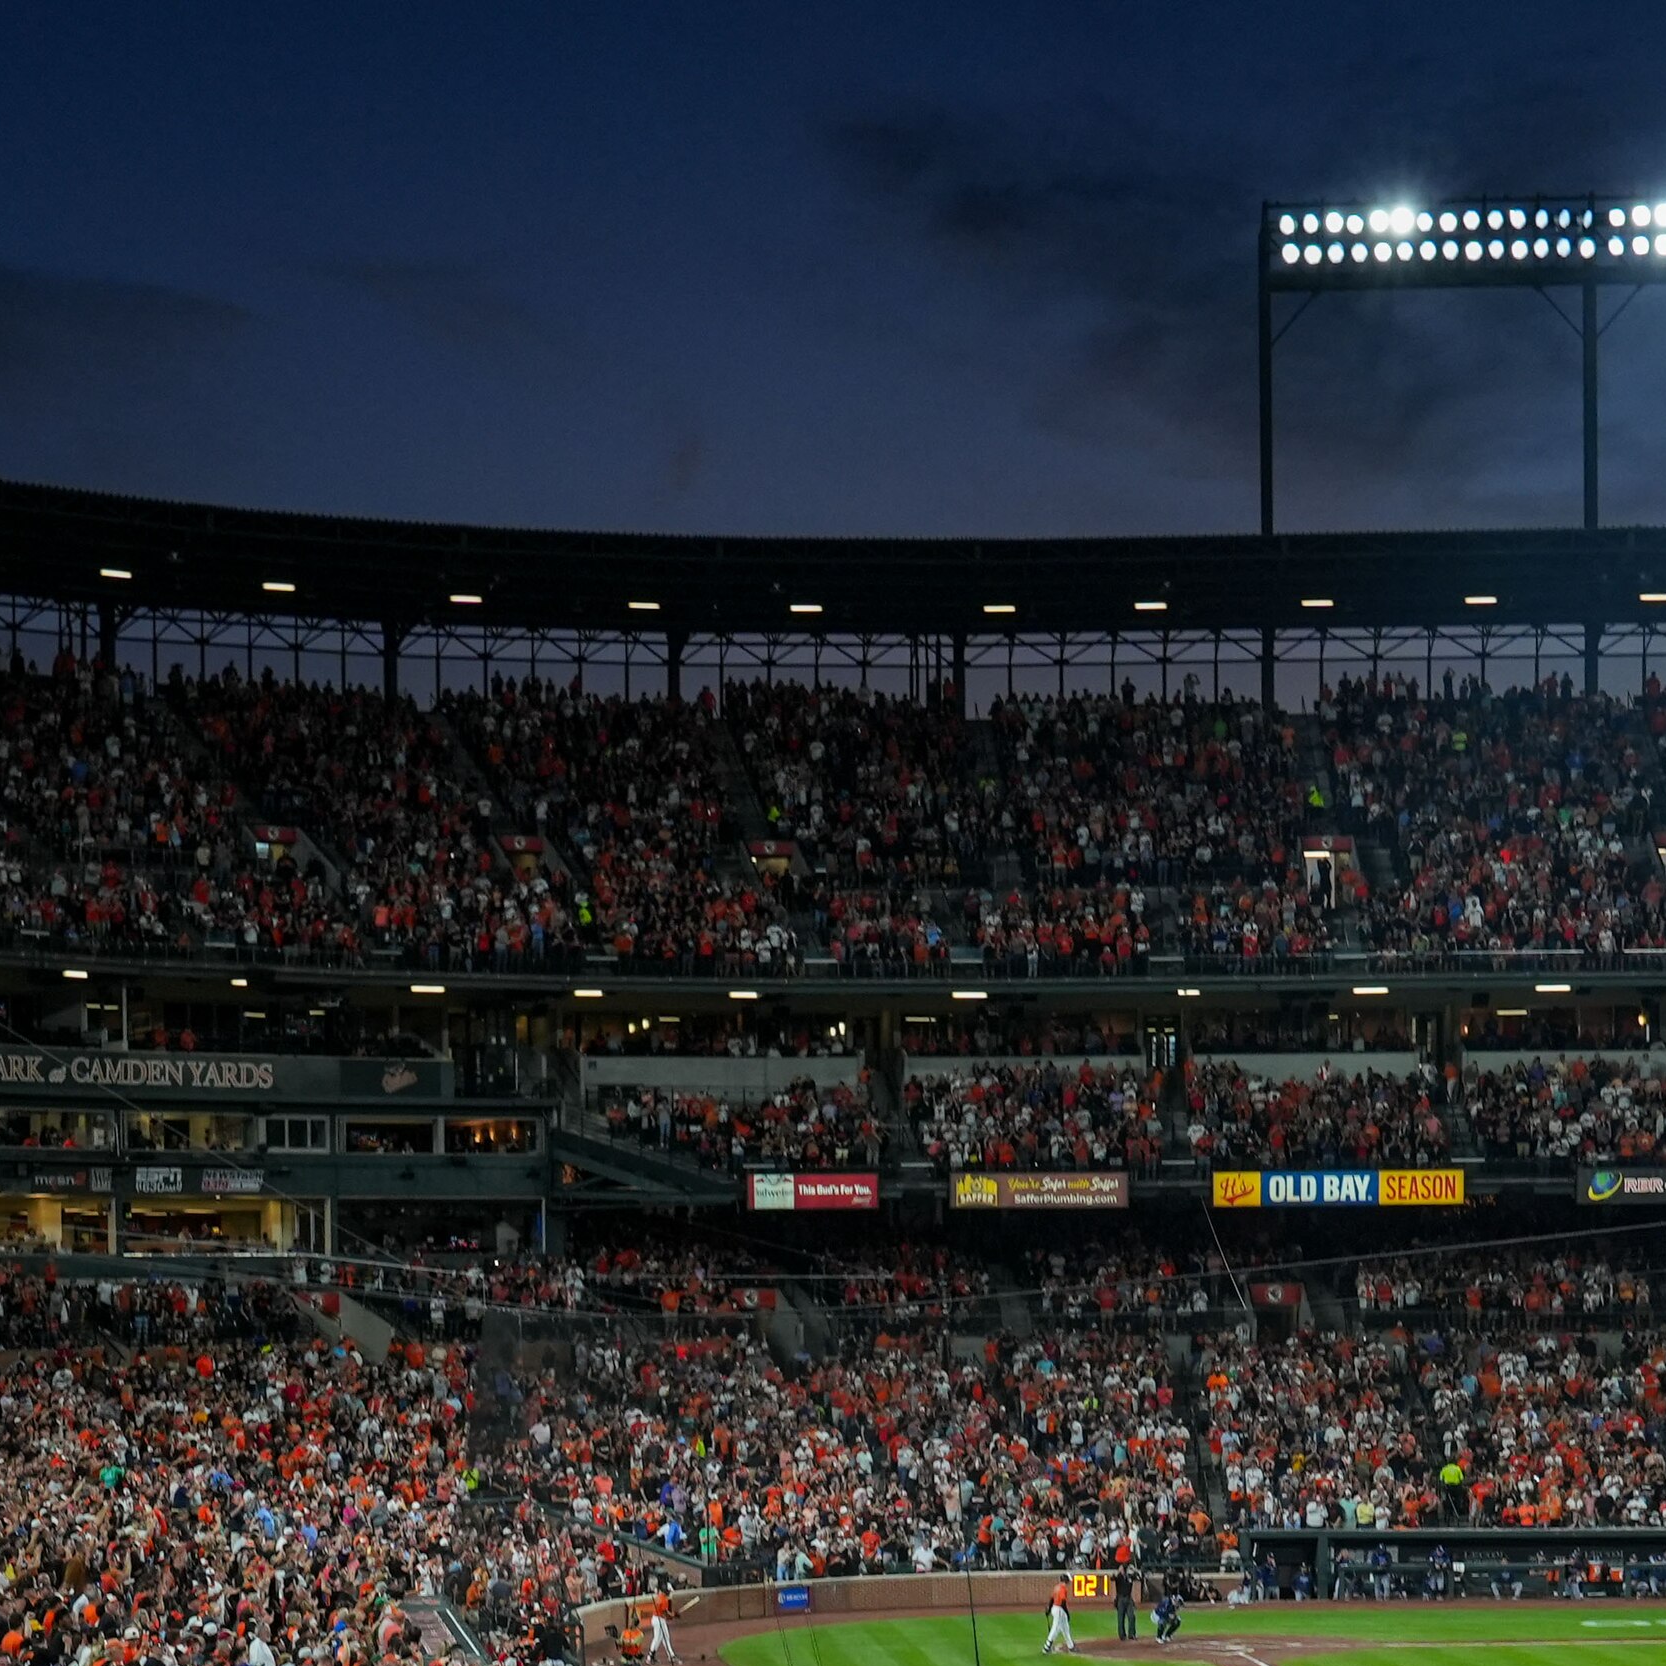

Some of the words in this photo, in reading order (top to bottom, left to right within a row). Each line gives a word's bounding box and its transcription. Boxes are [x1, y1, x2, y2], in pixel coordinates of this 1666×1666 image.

[70, 1056, 182, 1088] CAMDEN
[182, 1058, 274, 1090] YARDS
[136, 1166, 183, 1183] ESPN
[798, 1183, 815, 1197] This
[816, 1183, 840, 1197] Bud's
[841, 1184, 855, 1197] For
[1268, 1174, 1318, 1202] OLD
[1386, 1174, 1457, 1201] SEASON
[1014, 1193, 1118, 1207] SafferPlumbing.com
